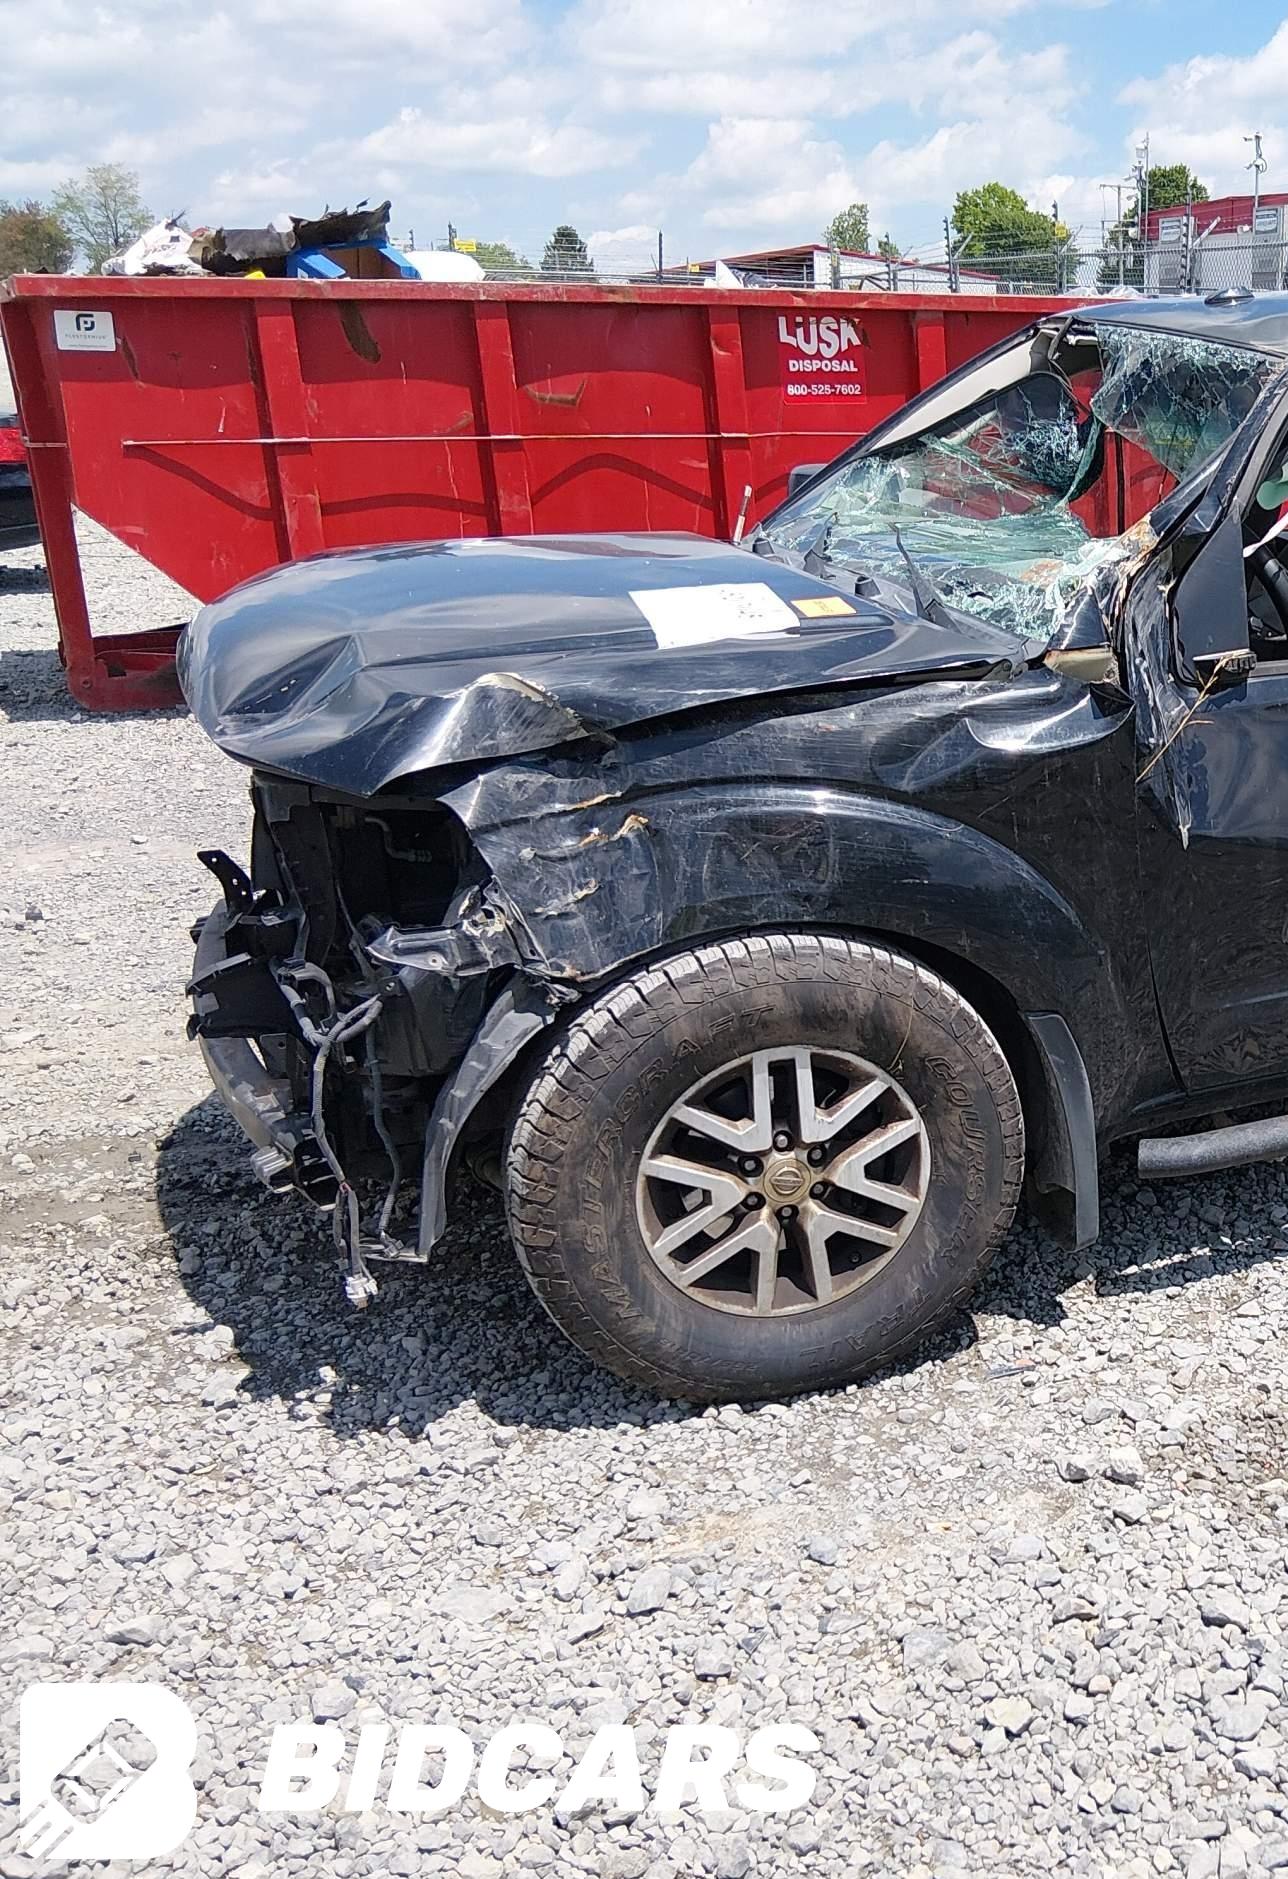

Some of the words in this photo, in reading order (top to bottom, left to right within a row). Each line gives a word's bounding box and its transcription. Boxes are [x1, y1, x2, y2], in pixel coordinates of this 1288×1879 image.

[778, 316, 862, 359] LUSK
[788, 360, 858, 372] DISPOSAL
[787, 384, 861, 396] 800-525-7602
[579, 1004, 774, 1320] MASTERCRAFT
